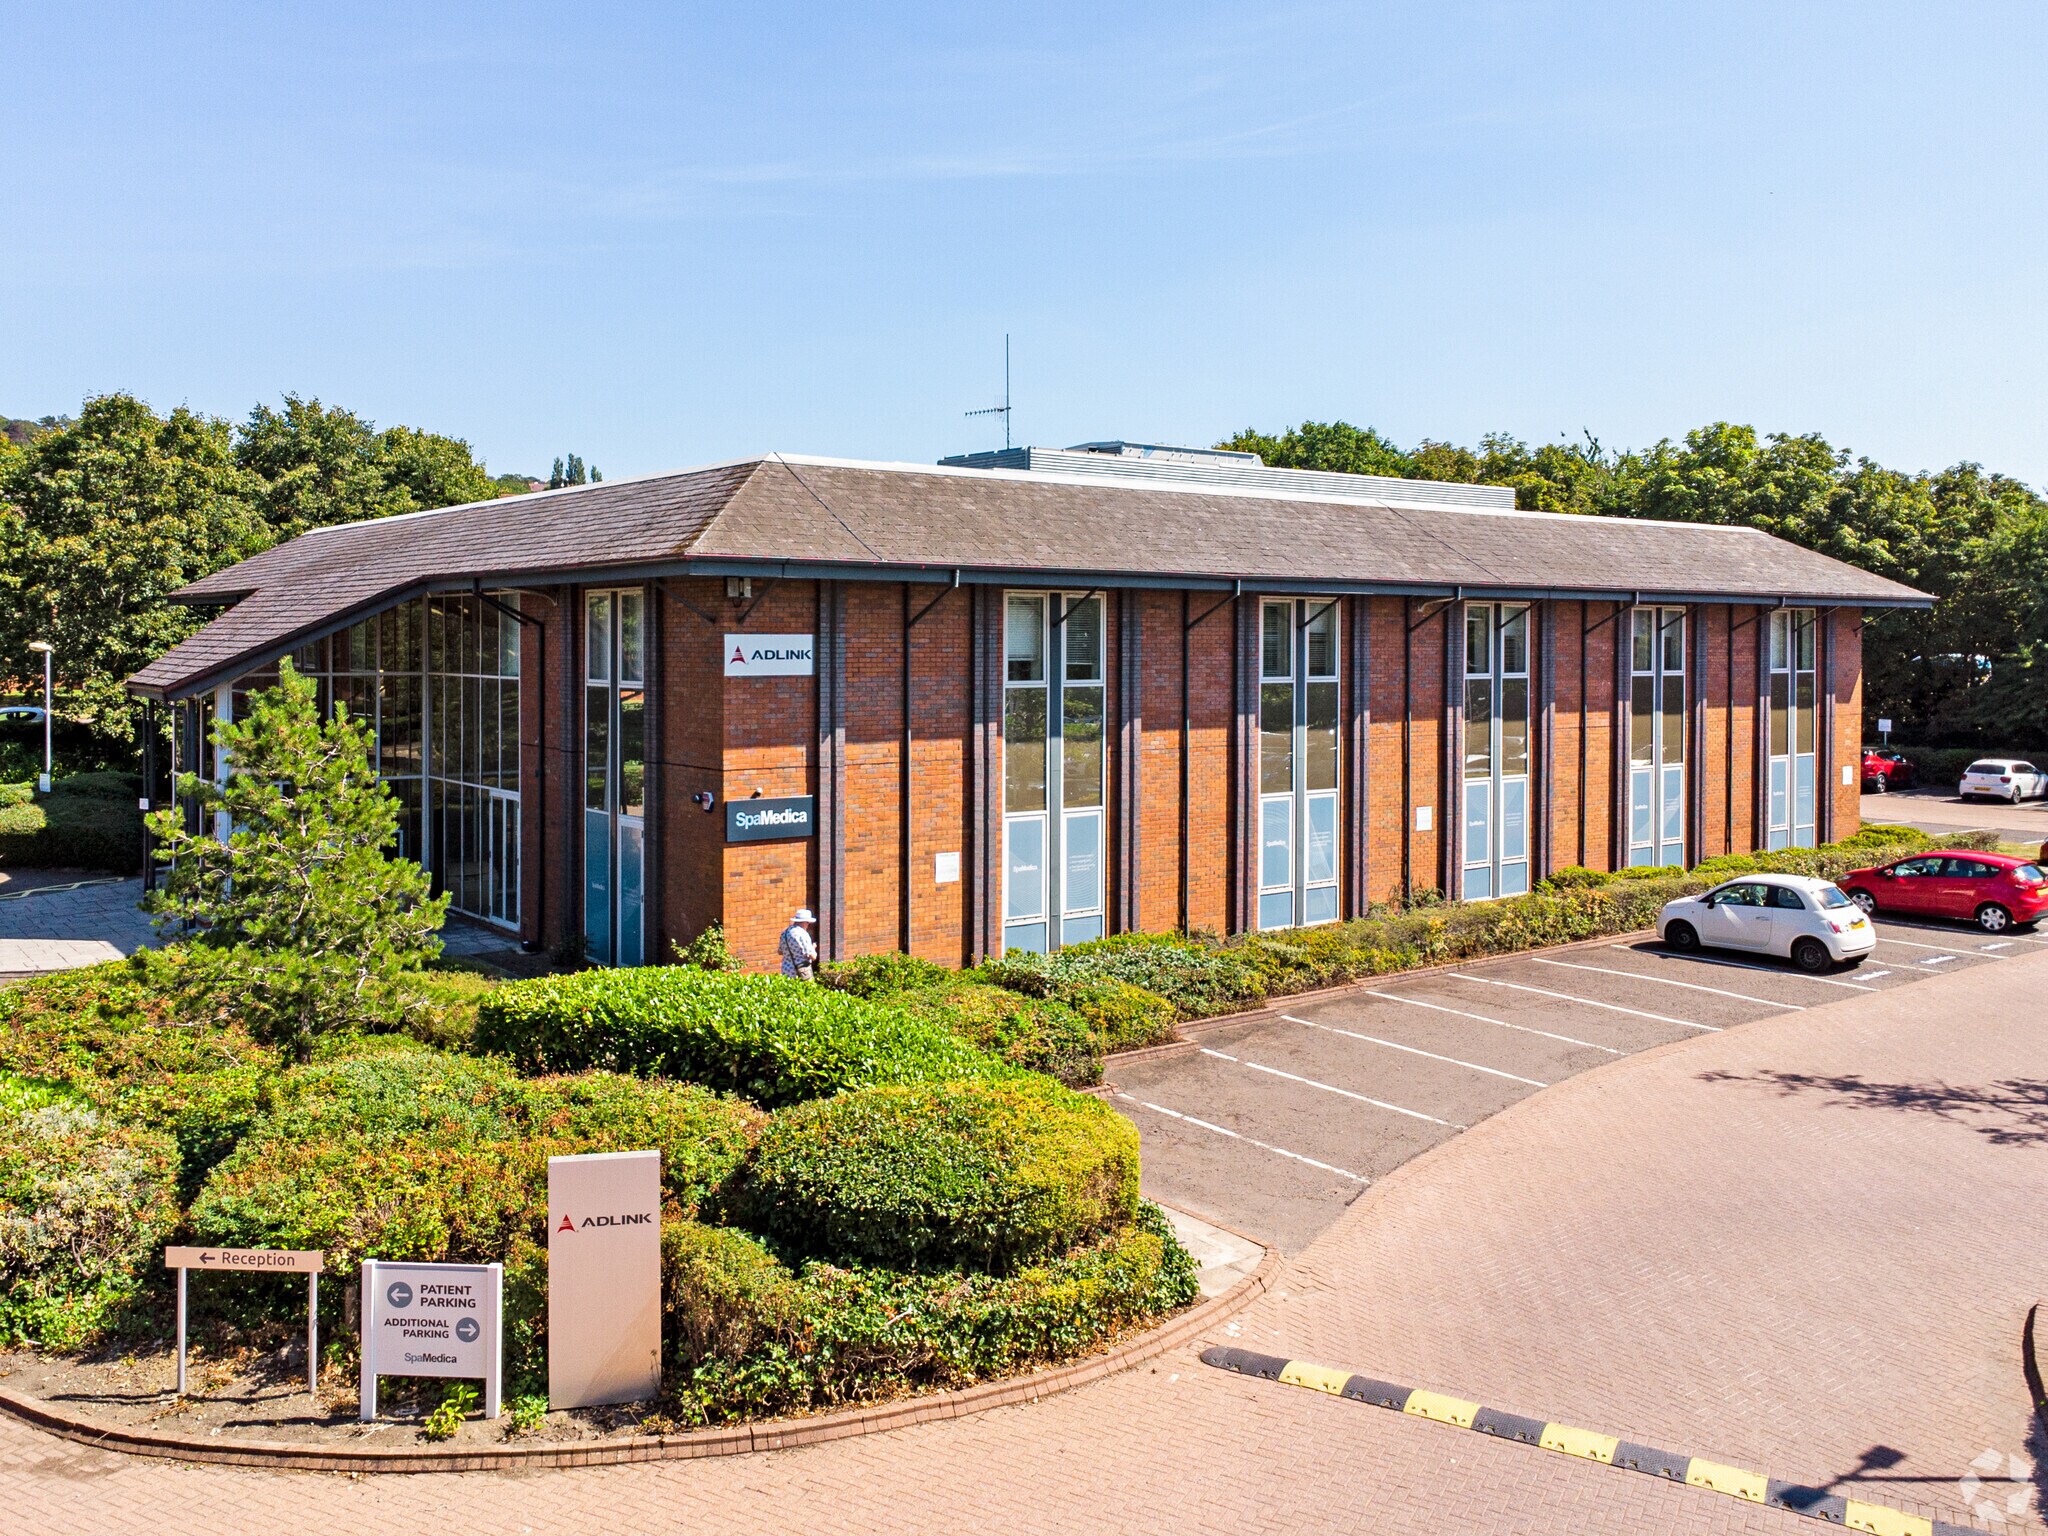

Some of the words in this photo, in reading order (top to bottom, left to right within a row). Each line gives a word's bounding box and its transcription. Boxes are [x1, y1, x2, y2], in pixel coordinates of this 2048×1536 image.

[751, 649, 812, 660] ADLINK
[735, 807, 808, 830] SpaMedica
[581, 1213, 652, 1228] ADLINK
[221, 1251, 295, 1267] Reception
[420, 1284, 472, 1295] PATIENT
[420, 1297, 476, 1308] PARKING
[384, 1318, 449, 1328] ADDITIONAL
[403, 1329, 449, 1339] PARKING
[404, 1352, 457, 1364] SpaMedica
